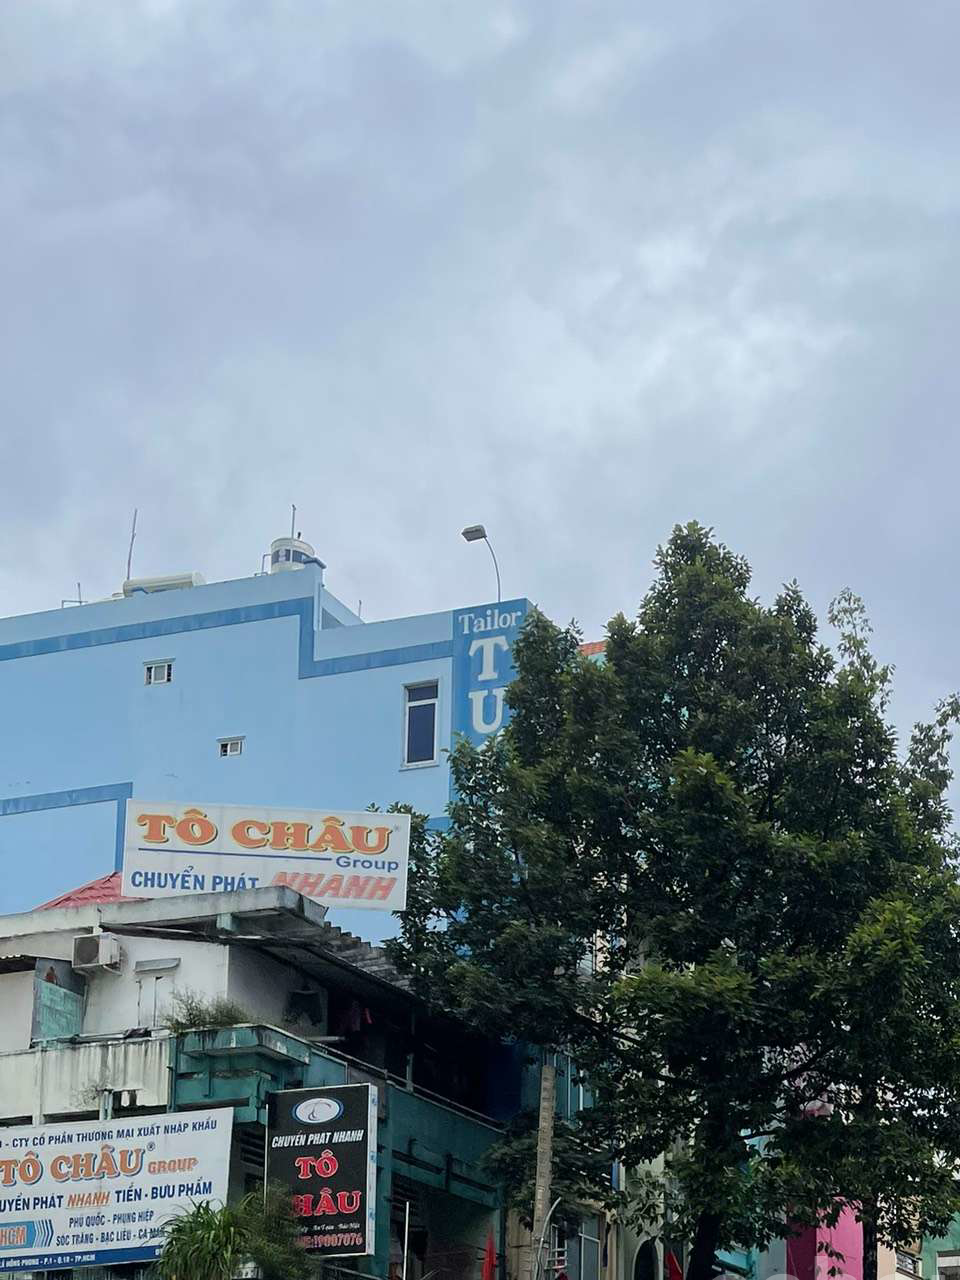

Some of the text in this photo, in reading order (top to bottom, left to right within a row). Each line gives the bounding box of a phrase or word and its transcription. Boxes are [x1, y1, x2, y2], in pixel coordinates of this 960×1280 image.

[458, 608, 522, 634] Tailor
[468, 635, 509, 750] TU
[136, 808, 393, 854] TÔ CHÂU
[335, 855, 399, 873] Group
[131, 865, 398, 901] CHUYỂN PHÁT NHANH
[12, 1137, 29, 1148] CTY
[332, 1129, 364, 1144] NHANH
[0, 1144, 199, 1187] TÔ CHÂU GROUP
[295, 1149, 339, 1179] TÔ
[67, 1191, 111, 1208] NHANH
[151, 1183, 175, 1200] BƯU
[291, 1187, 362, 1218] HÂU
